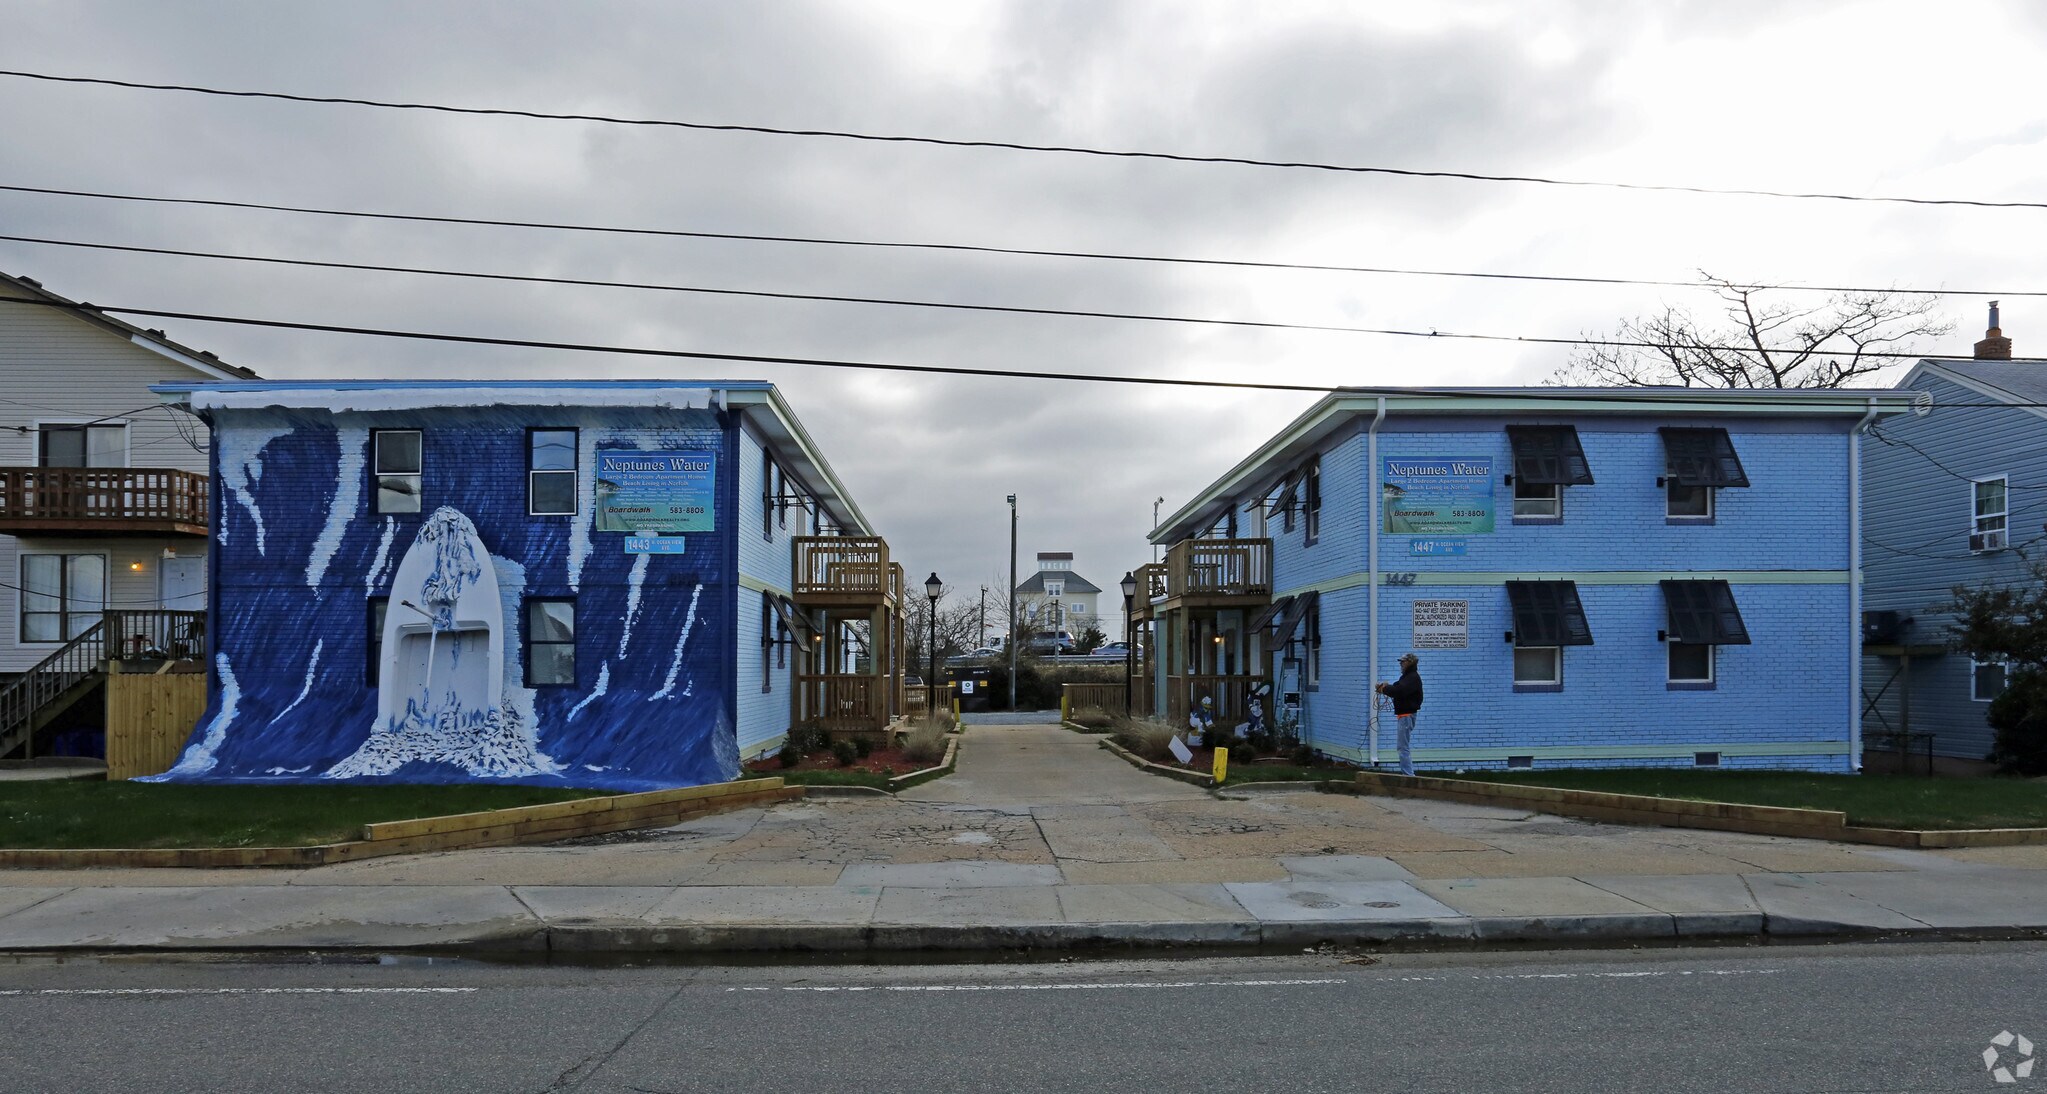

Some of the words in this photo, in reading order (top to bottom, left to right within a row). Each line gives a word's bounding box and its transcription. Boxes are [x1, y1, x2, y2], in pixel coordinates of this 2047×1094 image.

[603, 458, 665, 473] Neptunes
[669, 458, 710, 471] Water
[1388, 463, 1448, 478] Neptunes
[1451, 463, 1490, 475] Water
[628, 539, 650, 550] 1443
[1414, 542, 1434, 552] 1447
[1386, 573, 1417, 586] 1447
